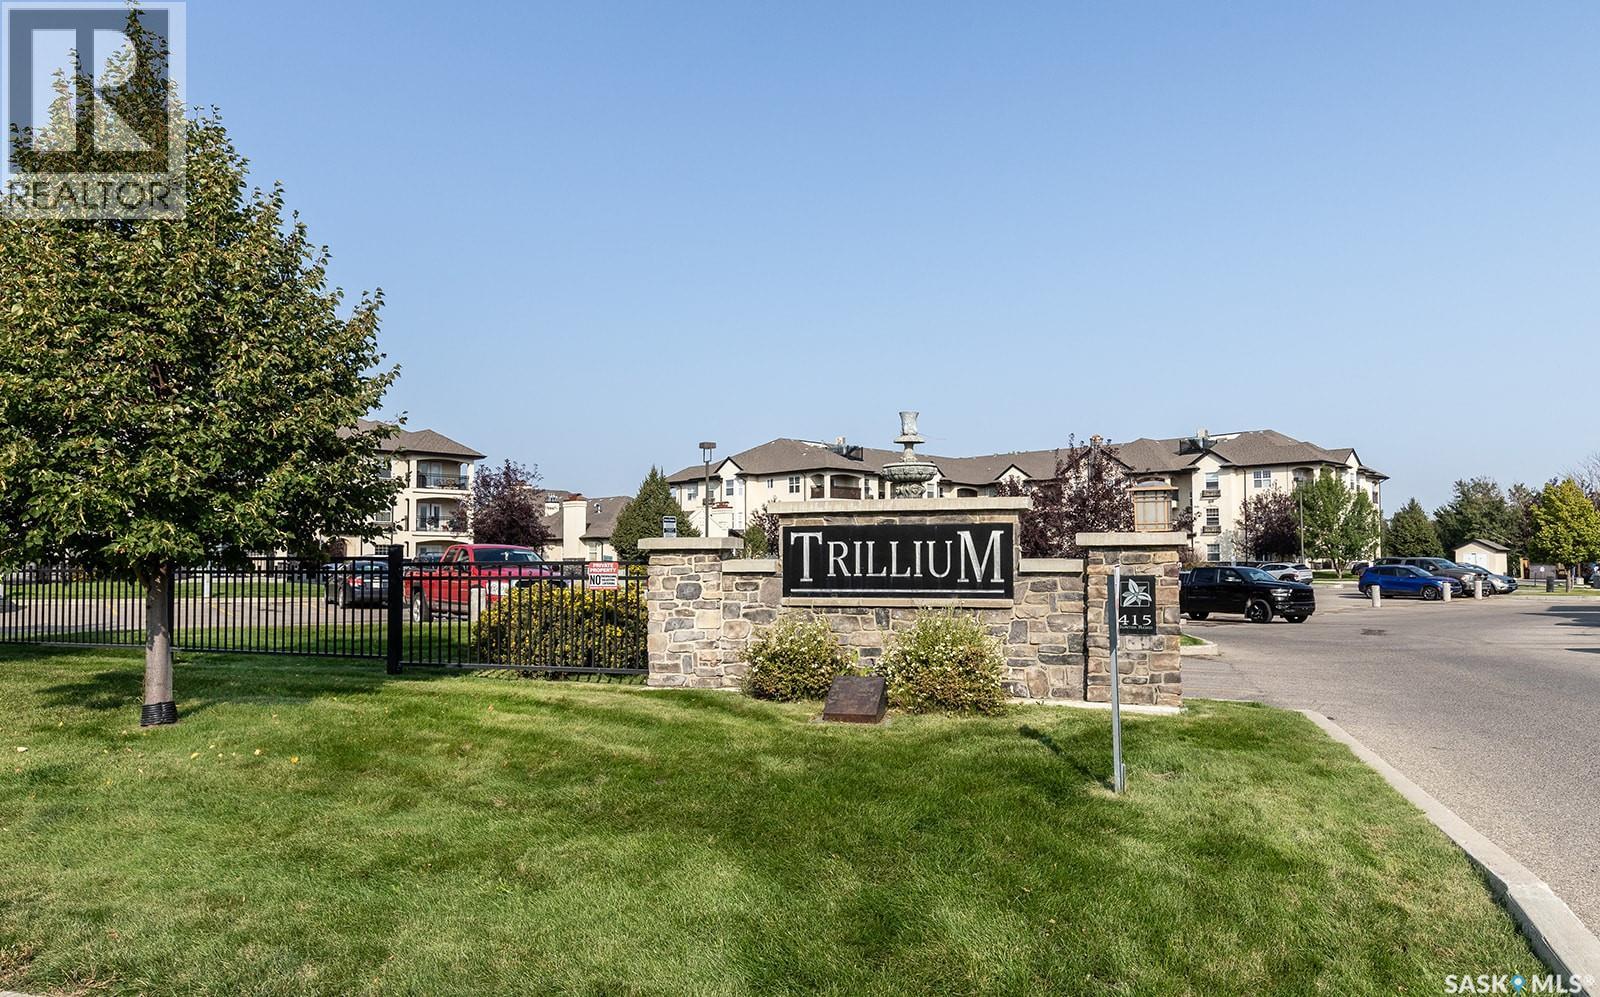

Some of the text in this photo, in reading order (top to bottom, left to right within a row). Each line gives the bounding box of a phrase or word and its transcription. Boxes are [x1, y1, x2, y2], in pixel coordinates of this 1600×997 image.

[790, 530, 1005, 583] TRILLIUM
[590, 574, 601, 586] NO
[1119, 614, 1152, 626] 415
